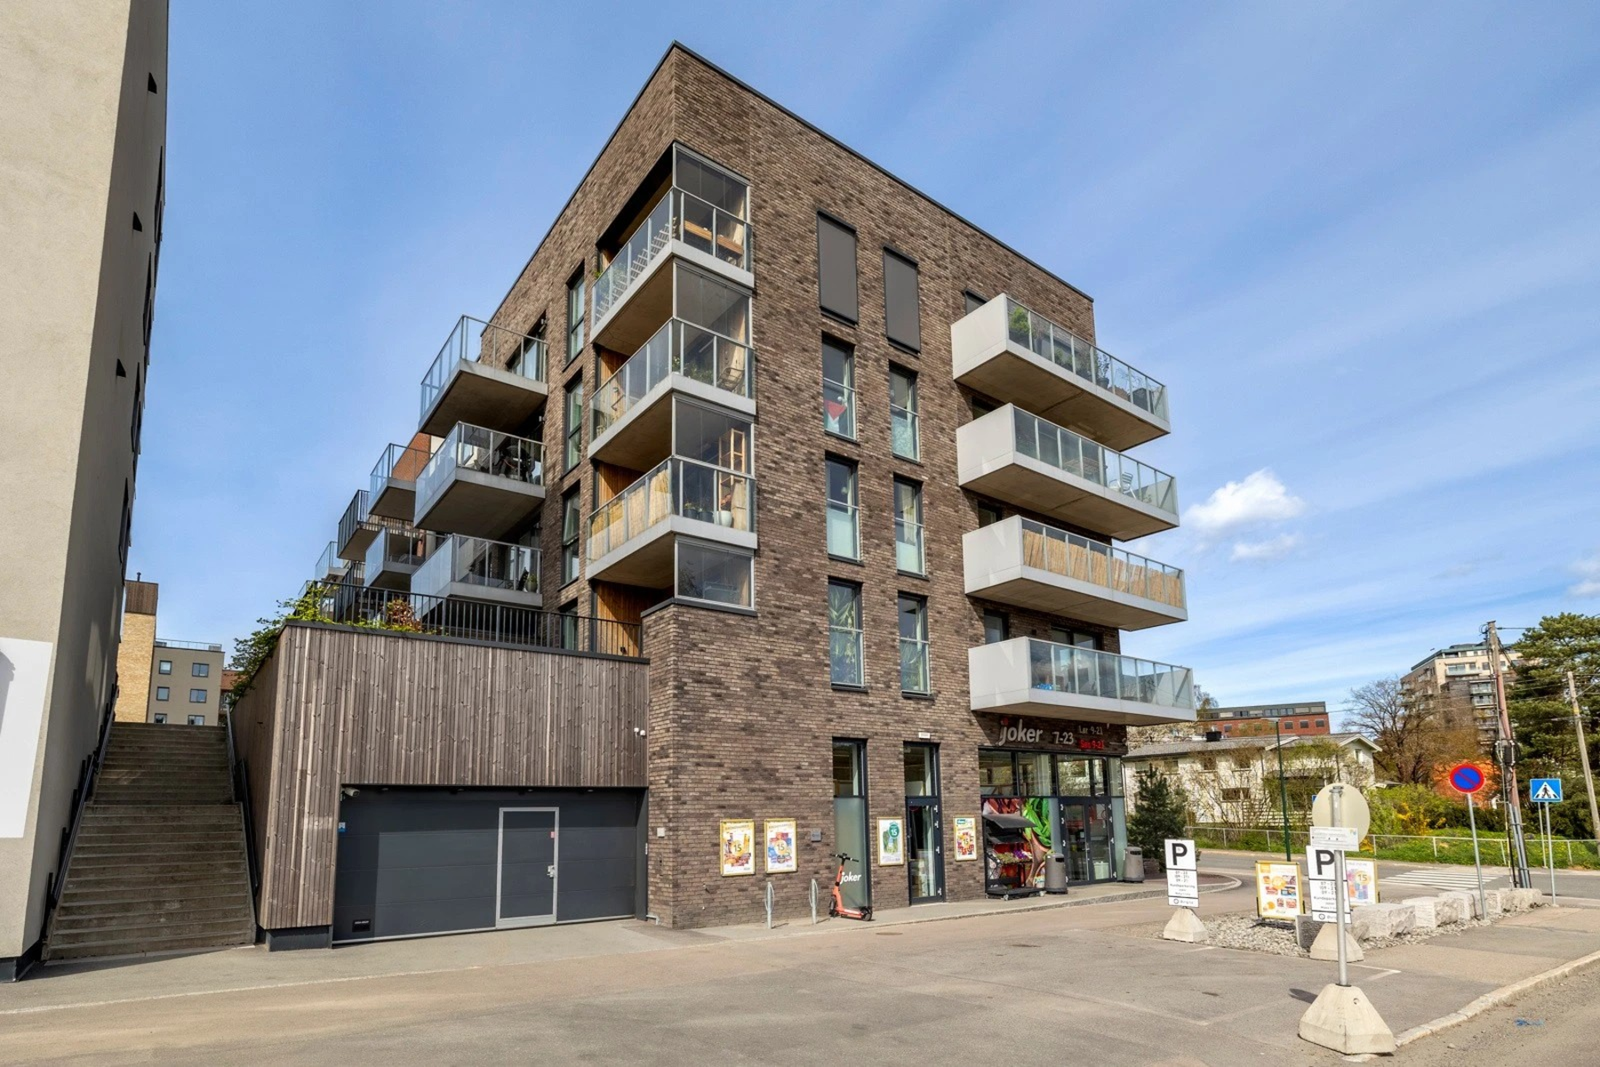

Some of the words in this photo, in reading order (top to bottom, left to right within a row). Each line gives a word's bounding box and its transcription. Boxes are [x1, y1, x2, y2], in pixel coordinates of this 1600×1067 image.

[996, 718, 1043, 746] joker
[1052, 731, 1074, 745] 7-23
[734, 844, 742, 852] 15
[776, 843, 785, 851] 15
[1172, 843, 1188, 865] P
[1315, 850, 1335, 875] P
[840, 871, 862, 885] joker
[1358, 874, 1367, 882] 15
